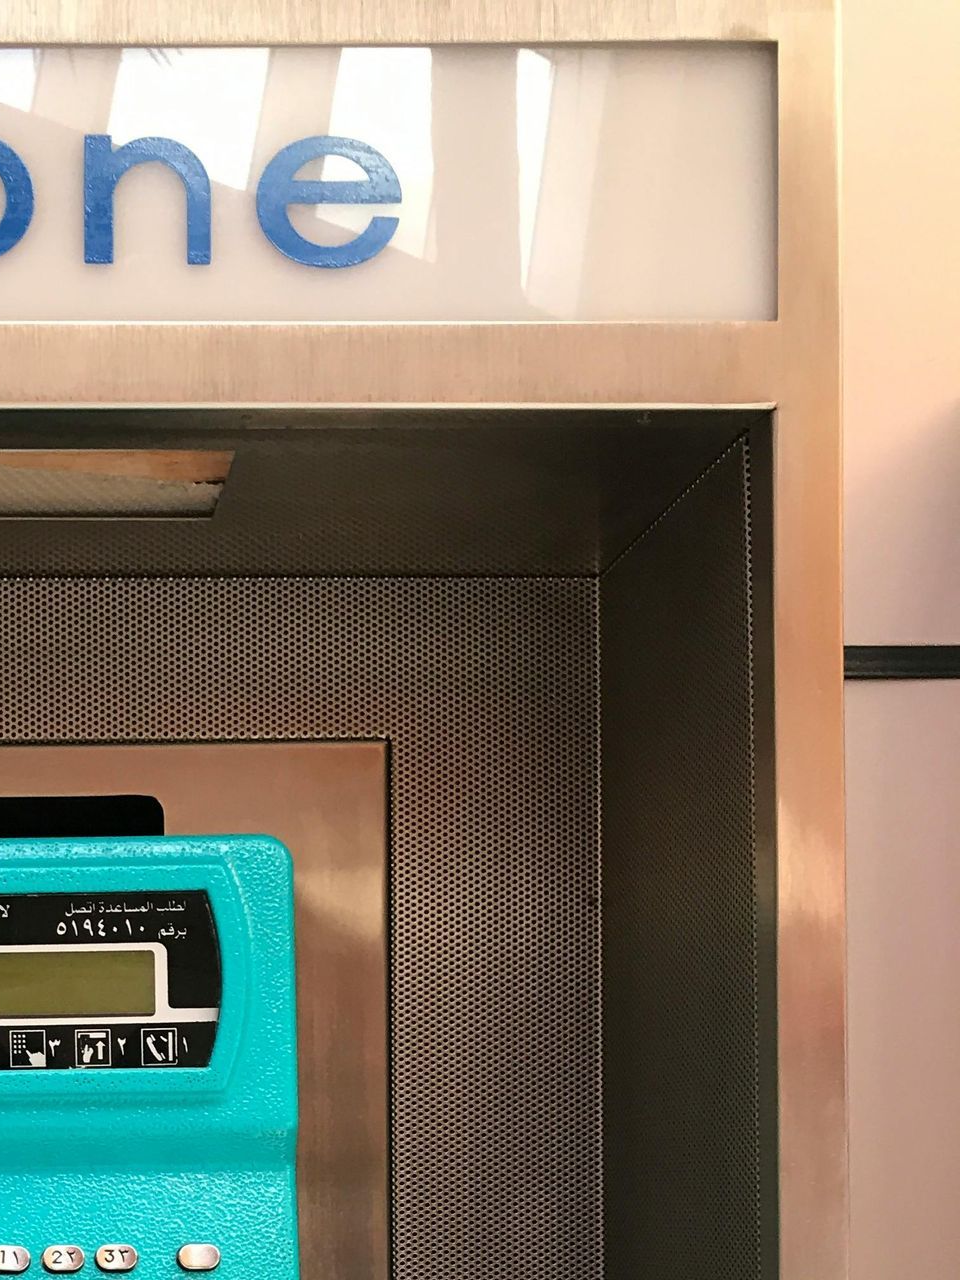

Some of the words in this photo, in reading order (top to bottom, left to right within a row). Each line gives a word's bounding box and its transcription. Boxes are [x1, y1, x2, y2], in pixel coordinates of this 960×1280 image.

[64, 901, 96, 917] اتصل
[99, 901, 154, 914] المساعدة
[156, 900, 187, 915] لطلب
[56, 918, 145, 937] ٥١٩٤٠١٠
[157, 922, 187, 940] برقم
[48, 1038, 61, 1057] ٣
[117, 1036, 127, 1056] ٢
[0, 1249, 6, 1264] 1
[51, 1250, 63, 1264] 2
[104, 1249, 115, 1263] 3
